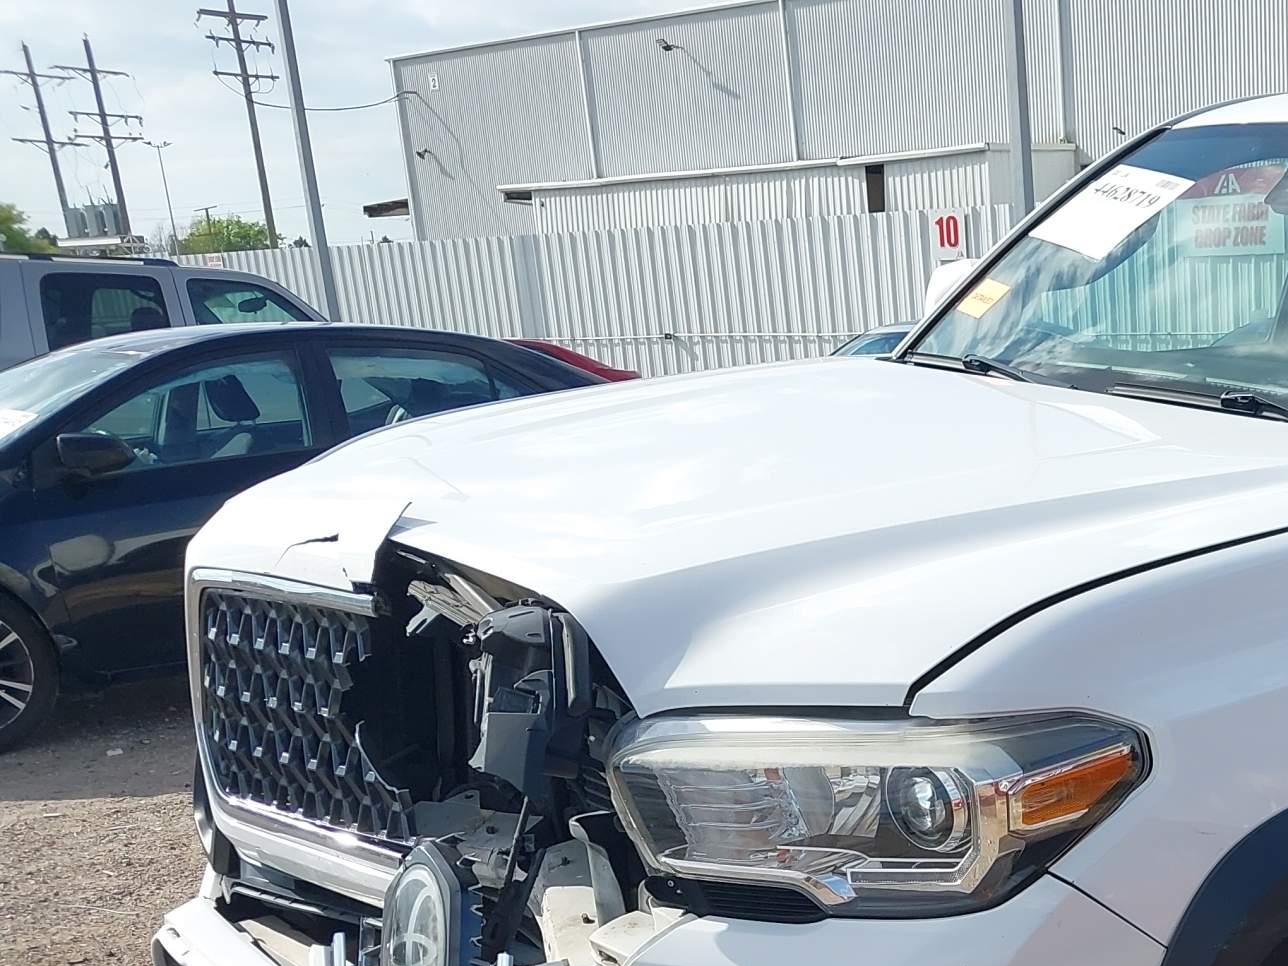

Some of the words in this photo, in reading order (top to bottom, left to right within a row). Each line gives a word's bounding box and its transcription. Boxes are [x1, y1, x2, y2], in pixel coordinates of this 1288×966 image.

[1192, 204, 1231, 224] STATE
[935, 215, 959, 248] 10
[1194, 226, 1231, 249] DROP
[1232, 225, 1267, 248] ZONE
